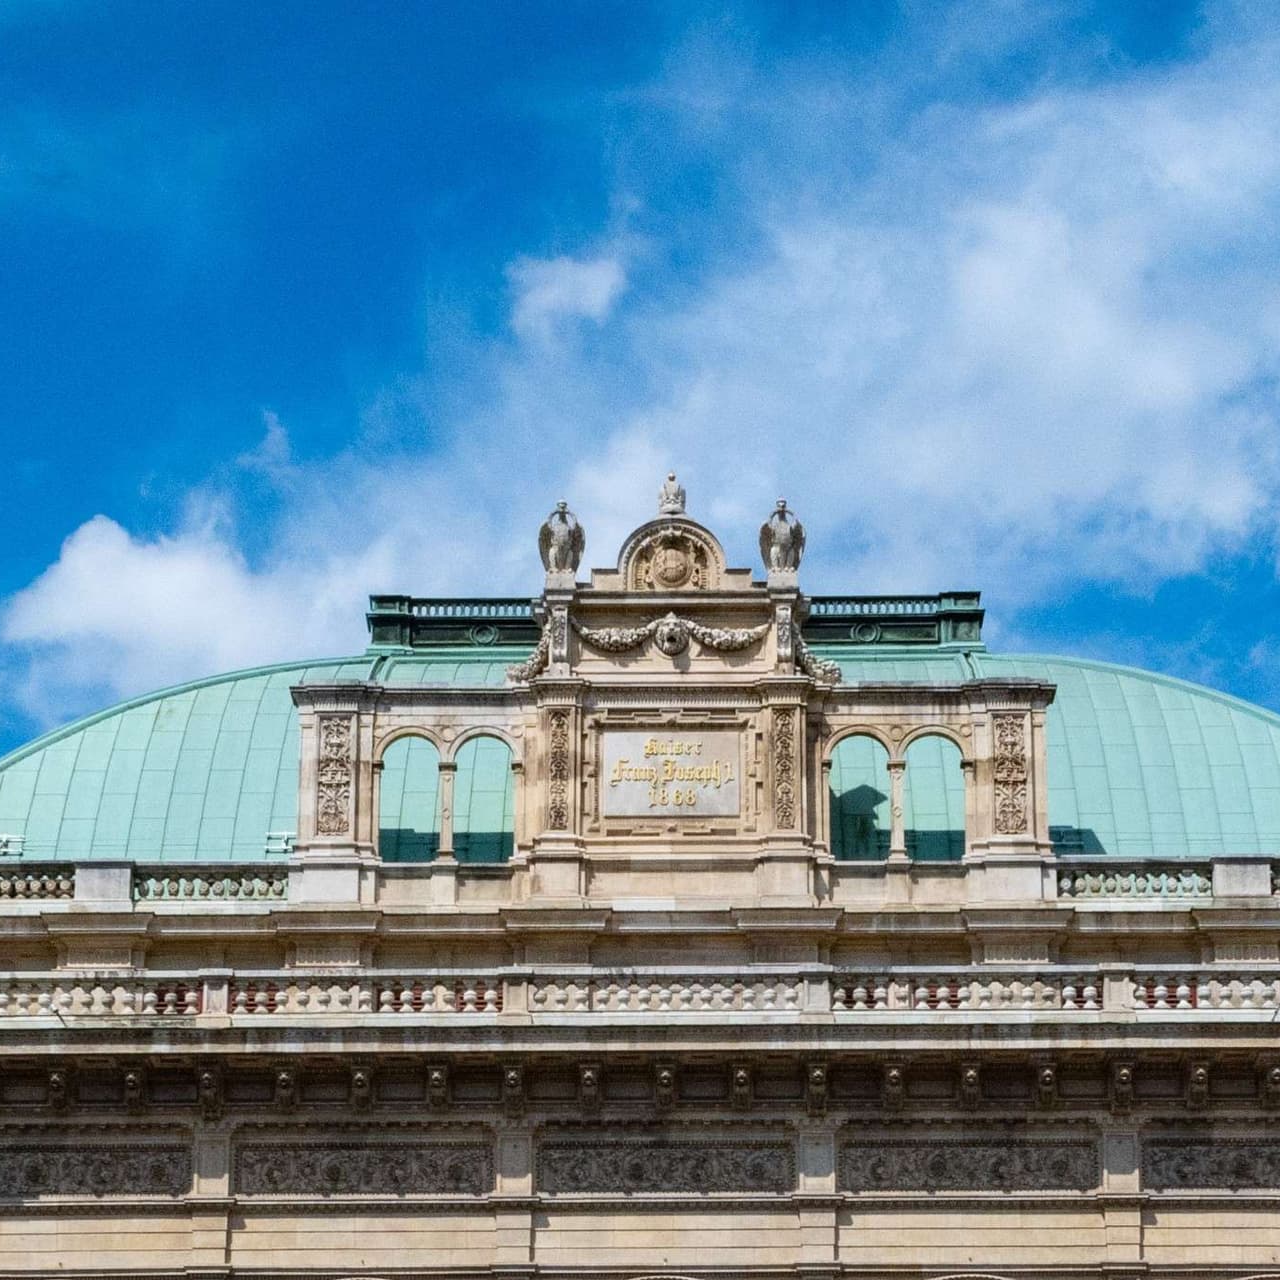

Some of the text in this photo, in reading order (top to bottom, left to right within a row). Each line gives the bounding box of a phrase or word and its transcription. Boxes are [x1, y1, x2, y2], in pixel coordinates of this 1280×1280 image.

[644, 738, 703, 759] Kaiser
[610, 759, 658, 789] Franz
[660, 759, 721, 789] Joseph
[648, 788, 697, 808] 1868
